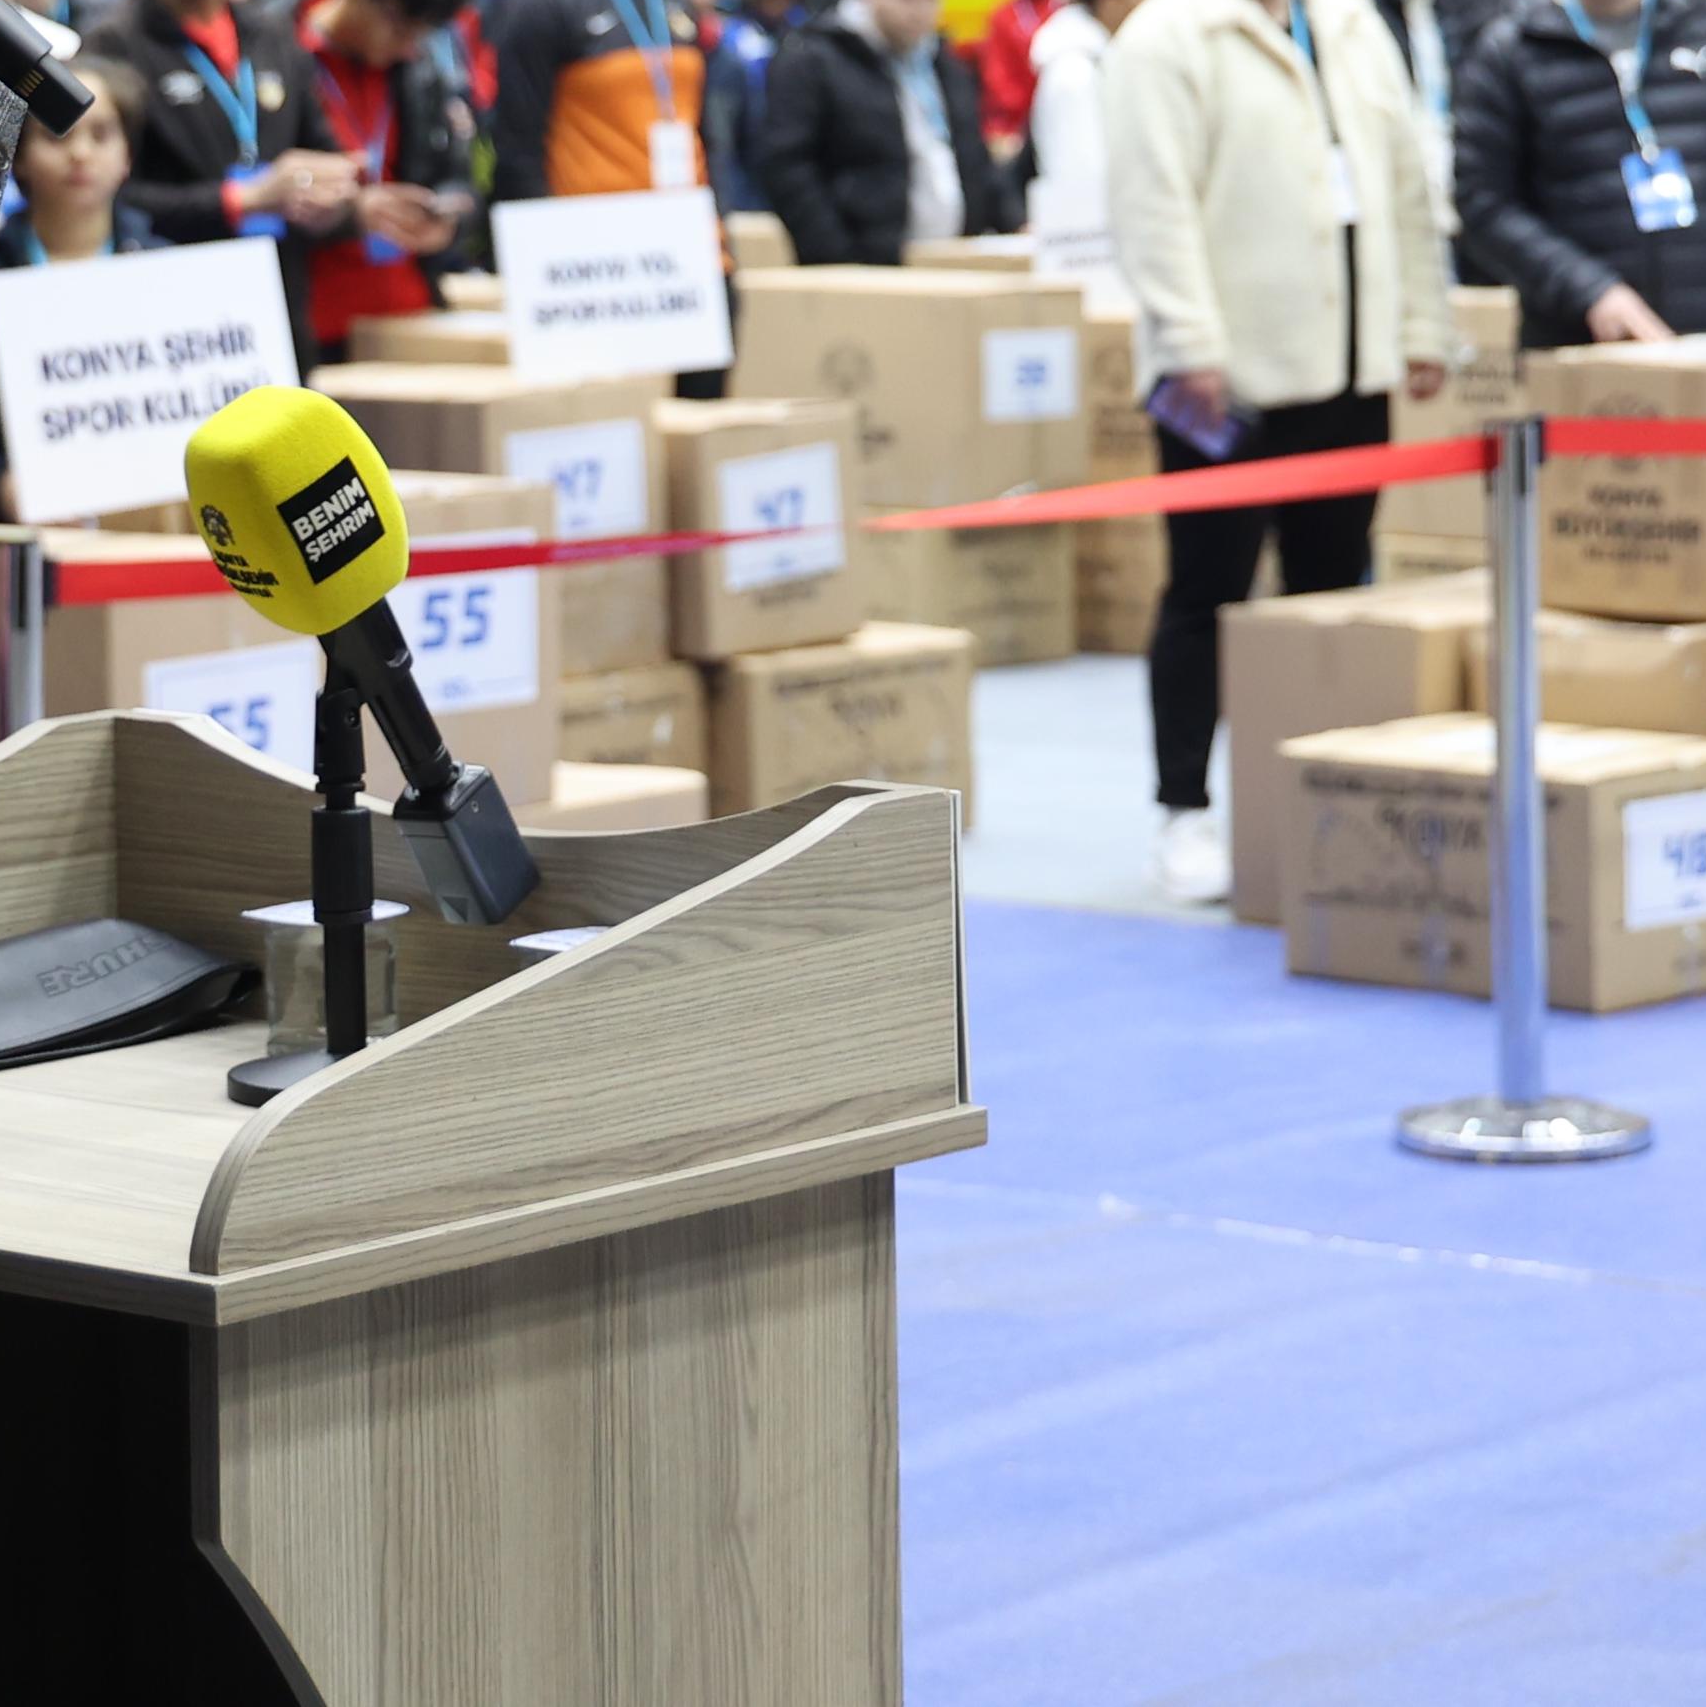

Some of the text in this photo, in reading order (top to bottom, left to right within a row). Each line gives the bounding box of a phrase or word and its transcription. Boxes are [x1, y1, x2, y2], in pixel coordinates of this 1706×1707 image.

[39, 319, 257, 383] KONYA ŞEHİR
[42, 397, 135, 443] SPOR
[291, 476, 367, 541] BENİM
[304, 499, 376, 564] ŞEHRİM
[418, 587, 495, 652] 55
[36, 933, 173, 998] SHURE
